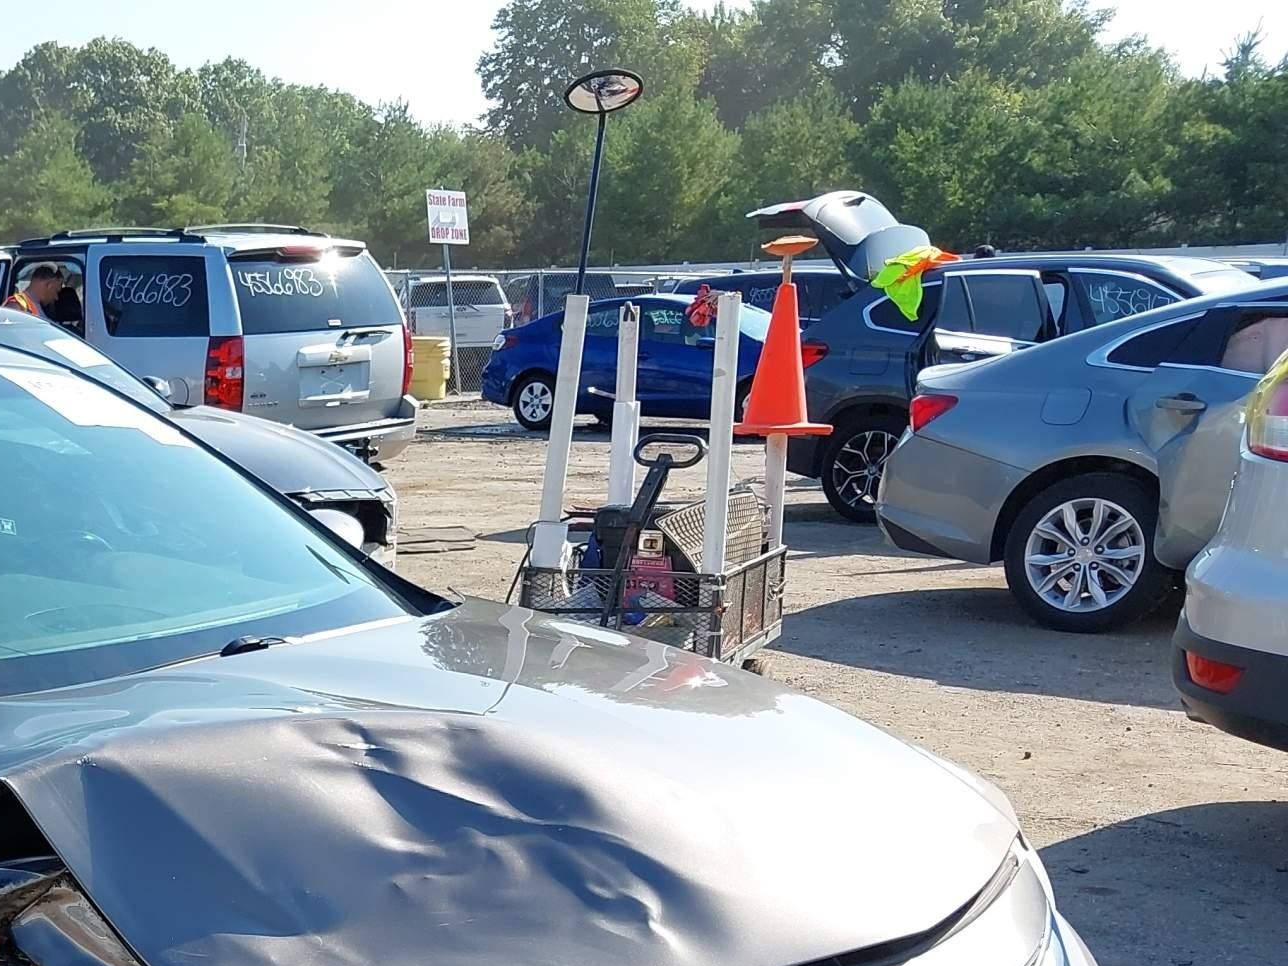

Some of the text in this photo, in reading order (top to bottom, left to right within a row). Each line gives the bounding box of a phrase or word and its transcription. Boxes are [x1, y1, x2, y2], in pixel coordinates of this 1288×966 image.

[428, 194, 465, 207] State Farm
[431, 227, 467, 240] DROP ZONE
[105, 268, 193, 307] 45566983
[238, 268, 323, 296] 45566983
